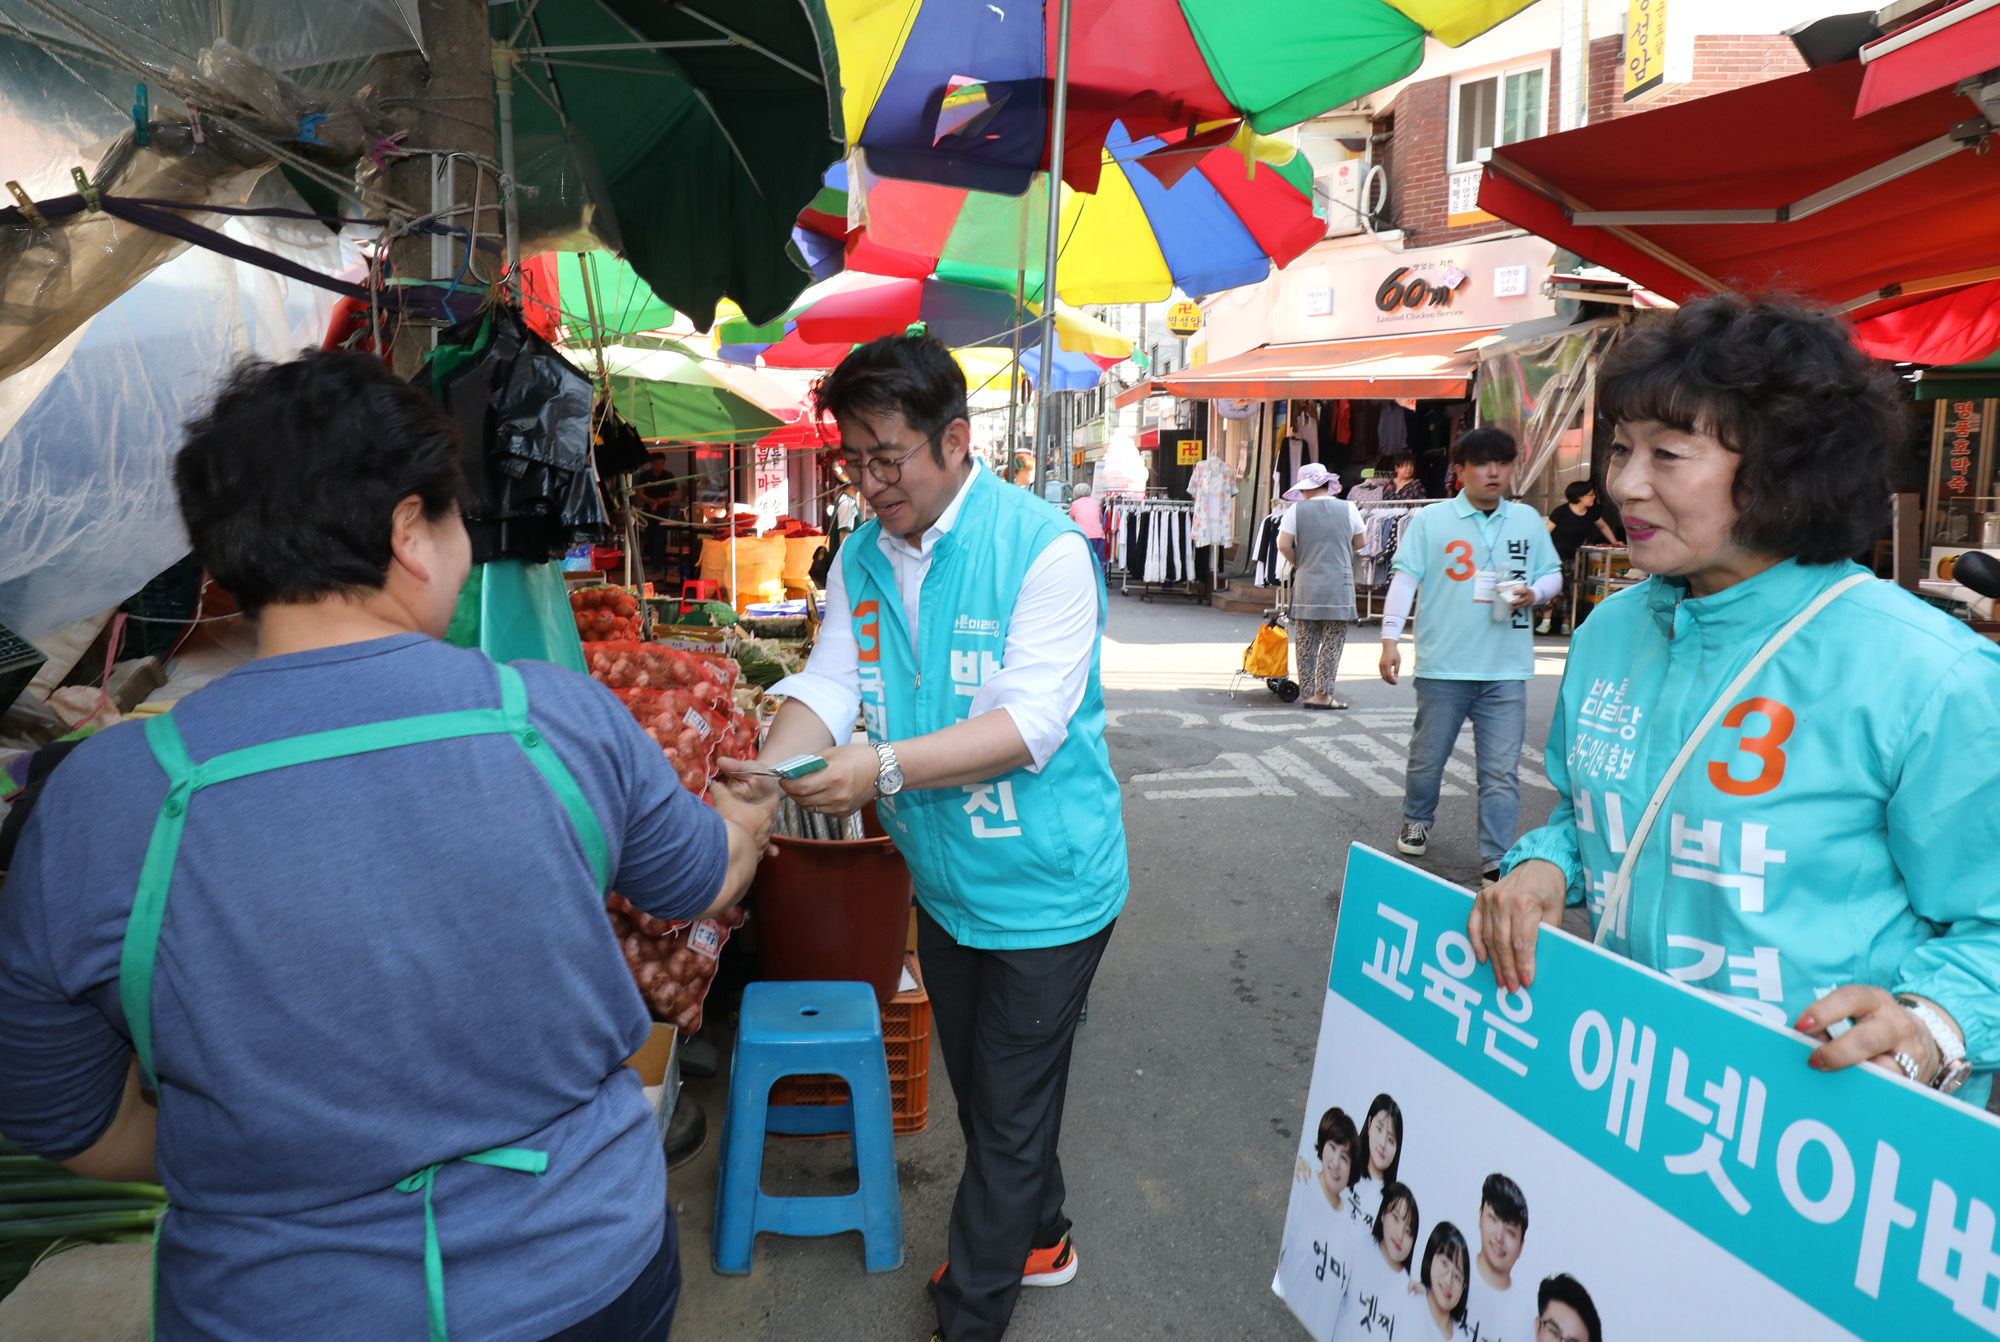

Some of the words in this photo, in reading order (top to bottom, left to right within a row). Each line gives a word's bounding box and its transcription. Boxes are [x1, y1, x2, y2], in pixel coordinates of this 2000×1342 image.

[1339, 178, 1349, 186] LG
[1168, 315, 1201, 328] 명성암
[1377, 314, 1404, 324] Limited
[1406, 312, 1435, 321] Chicken
[1437, 309, 1464, 318] Service
[1445, 540, 1476, 581] 3
[852, 600, 881, 663] 3
[950, 649, 1022, 840] 박진
[1707, 696, 1796, 797] 3
[1361, 902, 1539, 1077] 교육은
[1313, 1240, 1346, 1291] 엄마
